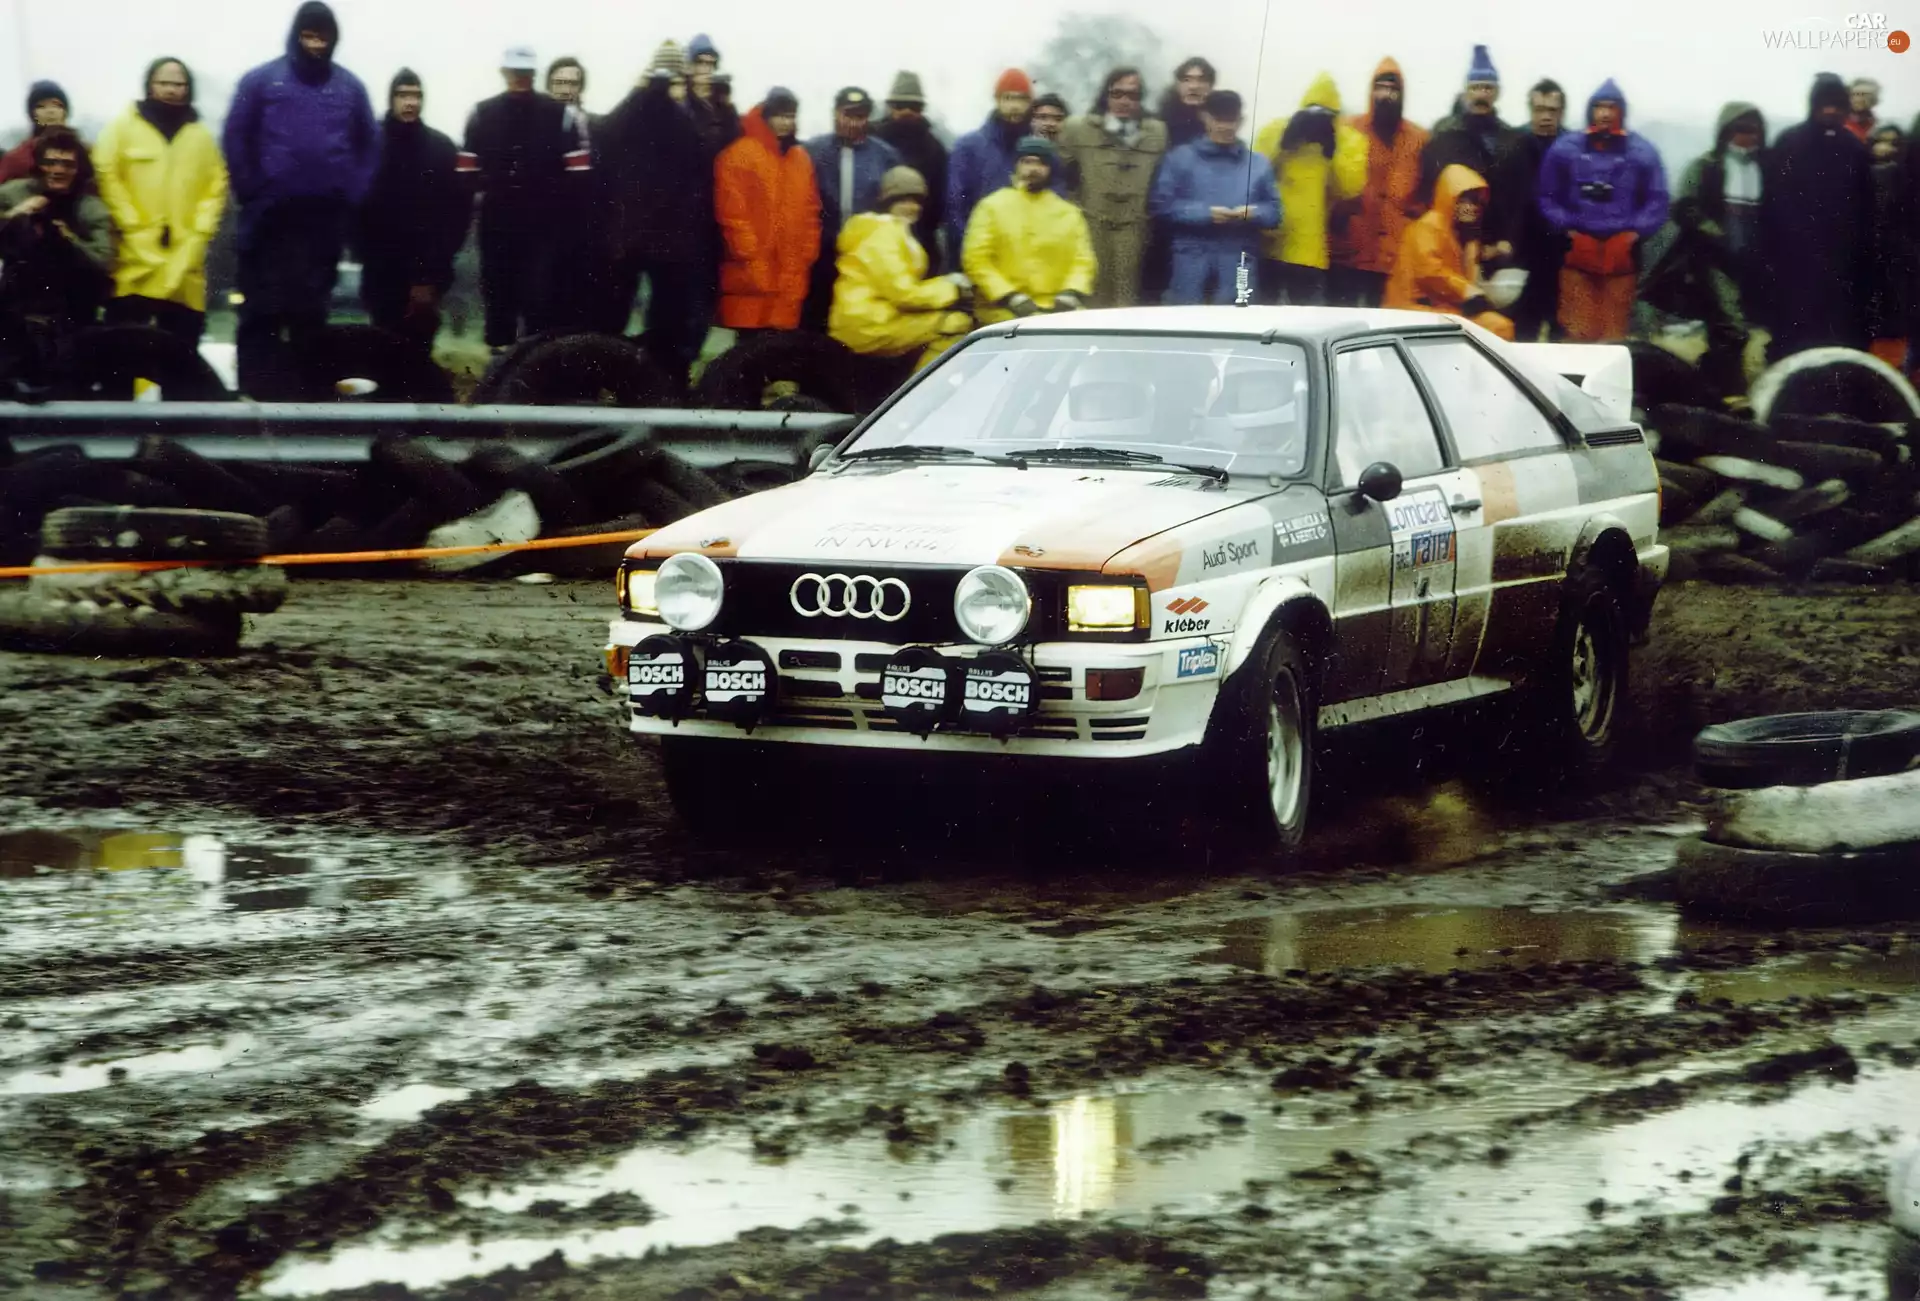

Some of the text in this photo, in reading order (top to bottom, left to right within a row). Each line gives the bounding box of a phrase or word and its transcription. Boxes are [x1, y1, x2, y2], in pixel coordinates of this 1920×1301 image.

[1203, 539, 1259, 570] Audi Sport
[629, 666, 683, 682] BOSCH
[706, 672, 765, 689] BOSCH
[884, 677, 945, 698] BOSCH
[965, 681, 1029, 702] BOSCH
